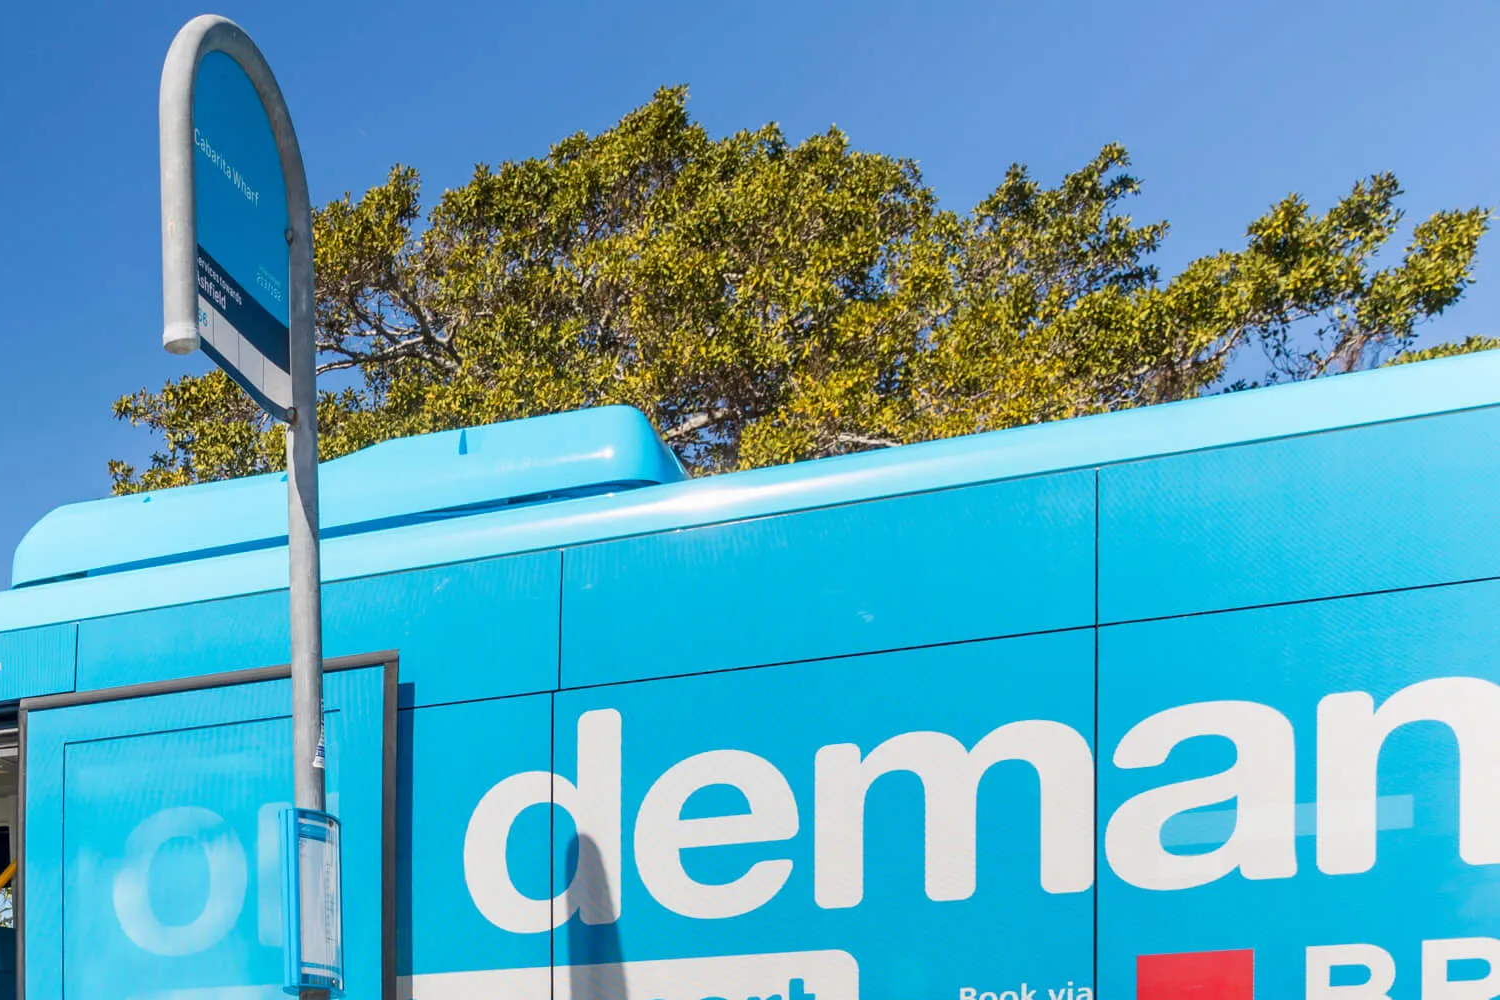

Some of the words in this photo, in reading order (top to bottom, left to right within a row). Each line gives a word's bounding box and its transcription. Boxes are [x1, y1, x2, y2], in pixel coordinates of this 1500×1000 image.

[194, 127, 232, 180] Cabarita
[232, 167, 260, 207] Wharf
[196, 256, 219, 285] ervices
[219, 276, 243, 306] towards
